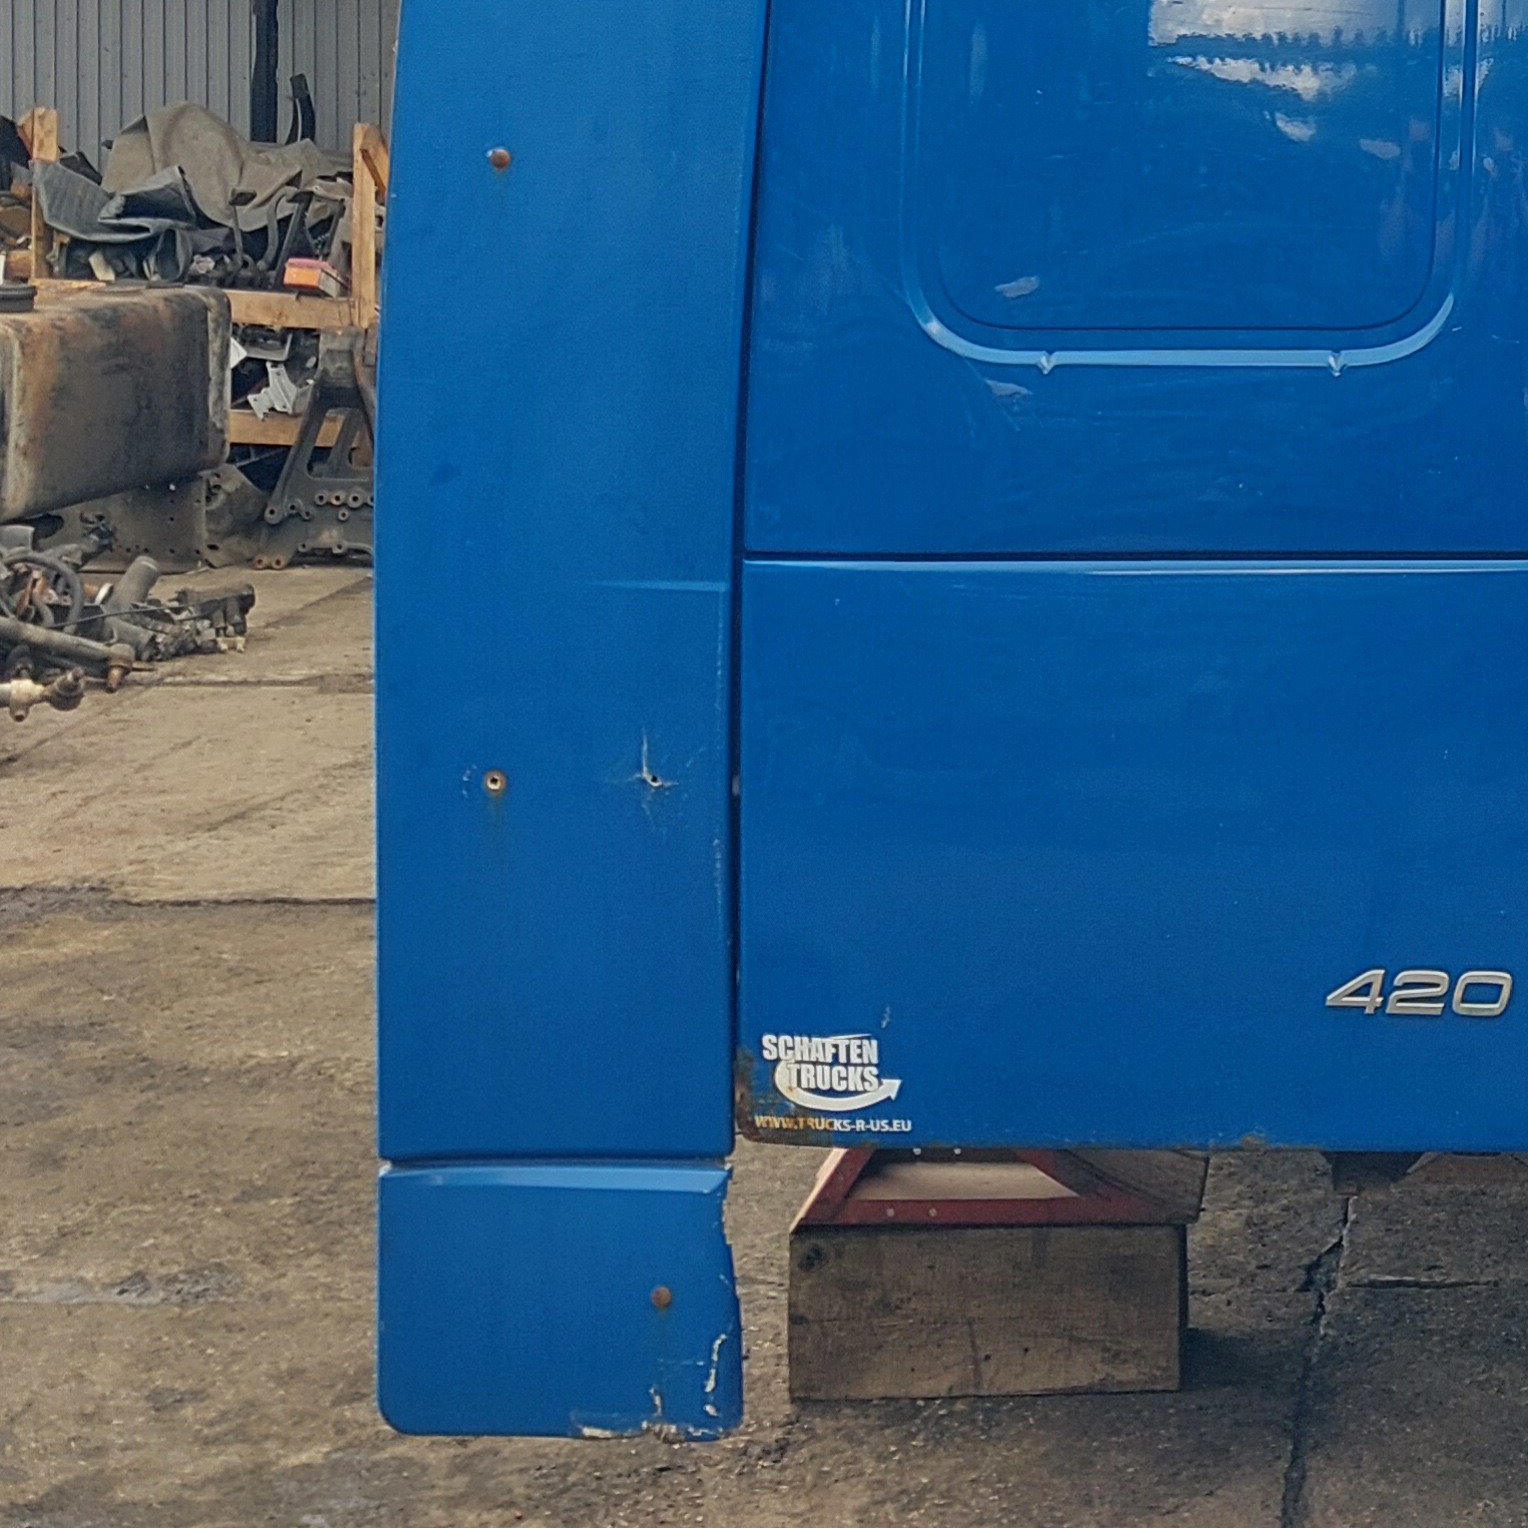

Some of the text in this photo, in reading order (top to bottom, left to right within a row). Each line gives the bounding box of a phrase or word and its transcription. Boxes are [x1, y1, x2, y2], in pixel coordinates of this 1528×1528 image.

[1325, 968, 1513, 1017] 420
[762, 1034, 879, 1065] SCHAFTEN
[786, 1062, 880, 1092] TRUCKS
[754, 1114, 913, 1133] WWW.TRUCKS-R-US.EU
